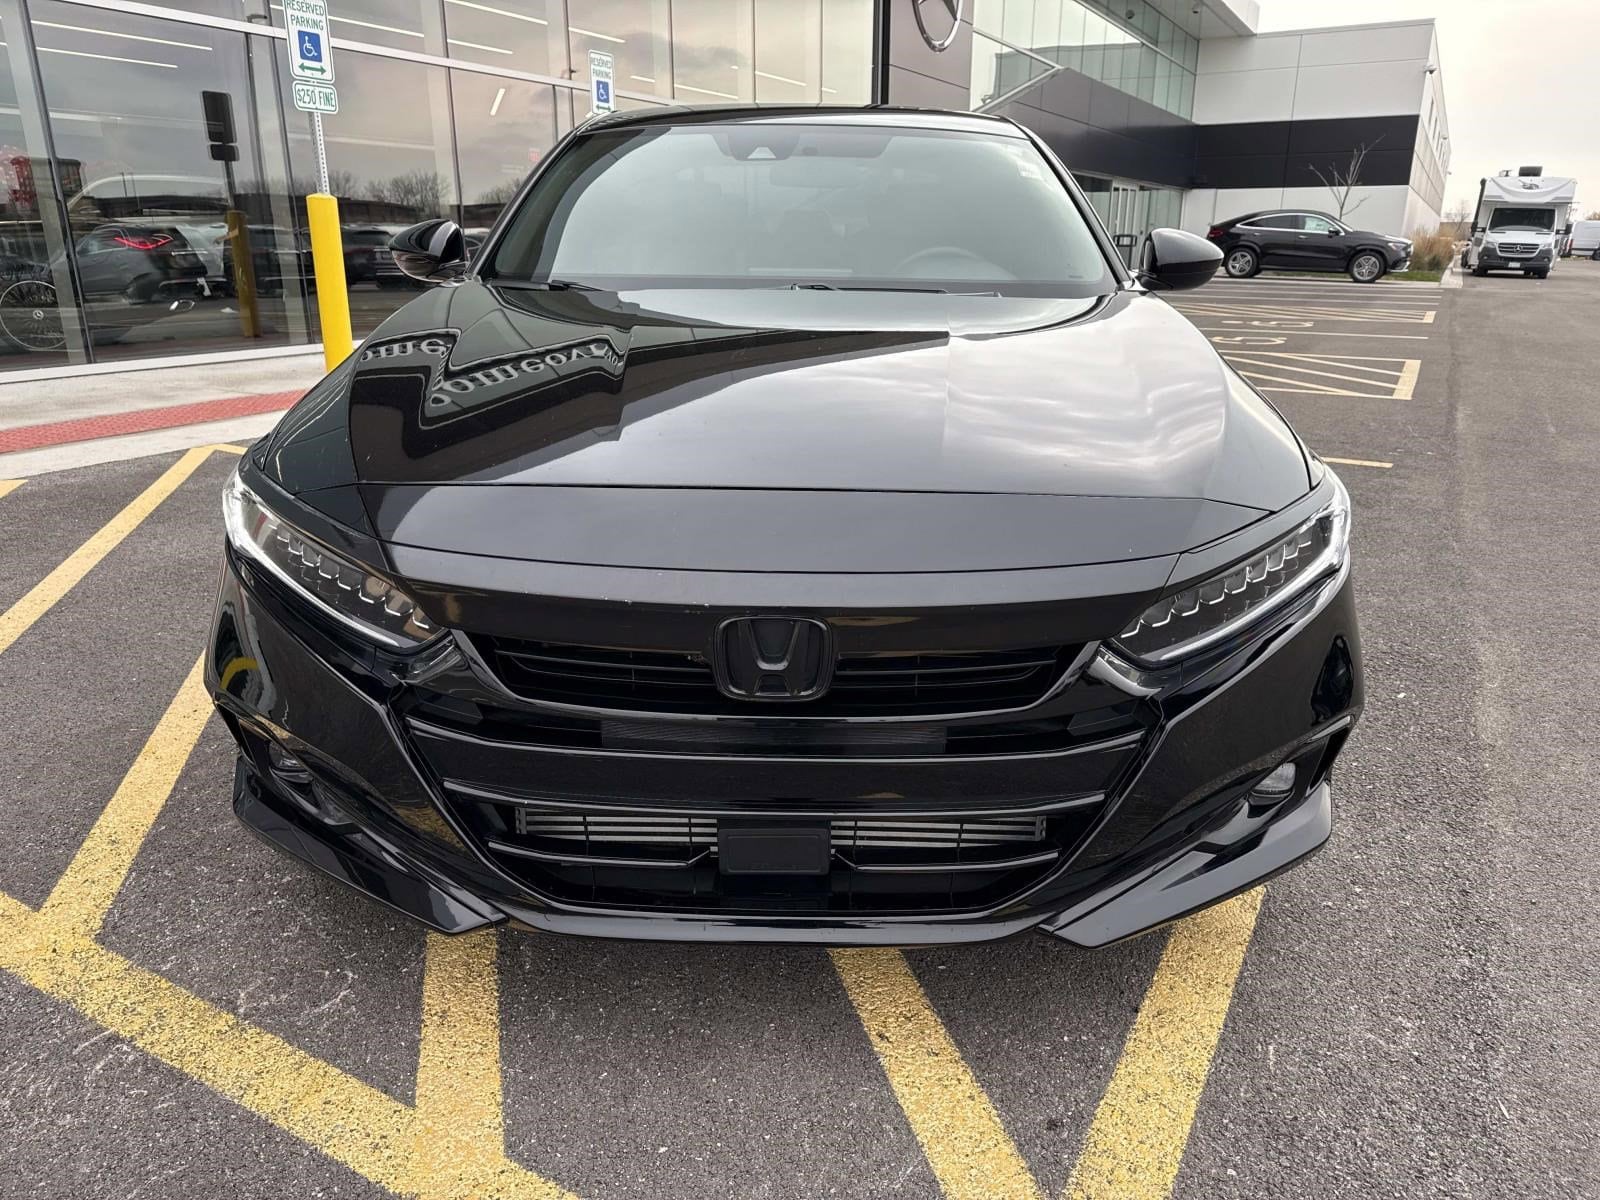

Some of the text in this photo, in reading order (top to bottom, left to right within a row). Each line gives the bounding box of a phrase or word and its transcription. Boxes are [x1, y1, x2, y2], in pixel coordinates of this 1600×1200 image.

[286, 0, 324, 16] RESERVED
[290, 14, 324, 31] PARKING
[296, 88, 335, 108] $250 FINE
